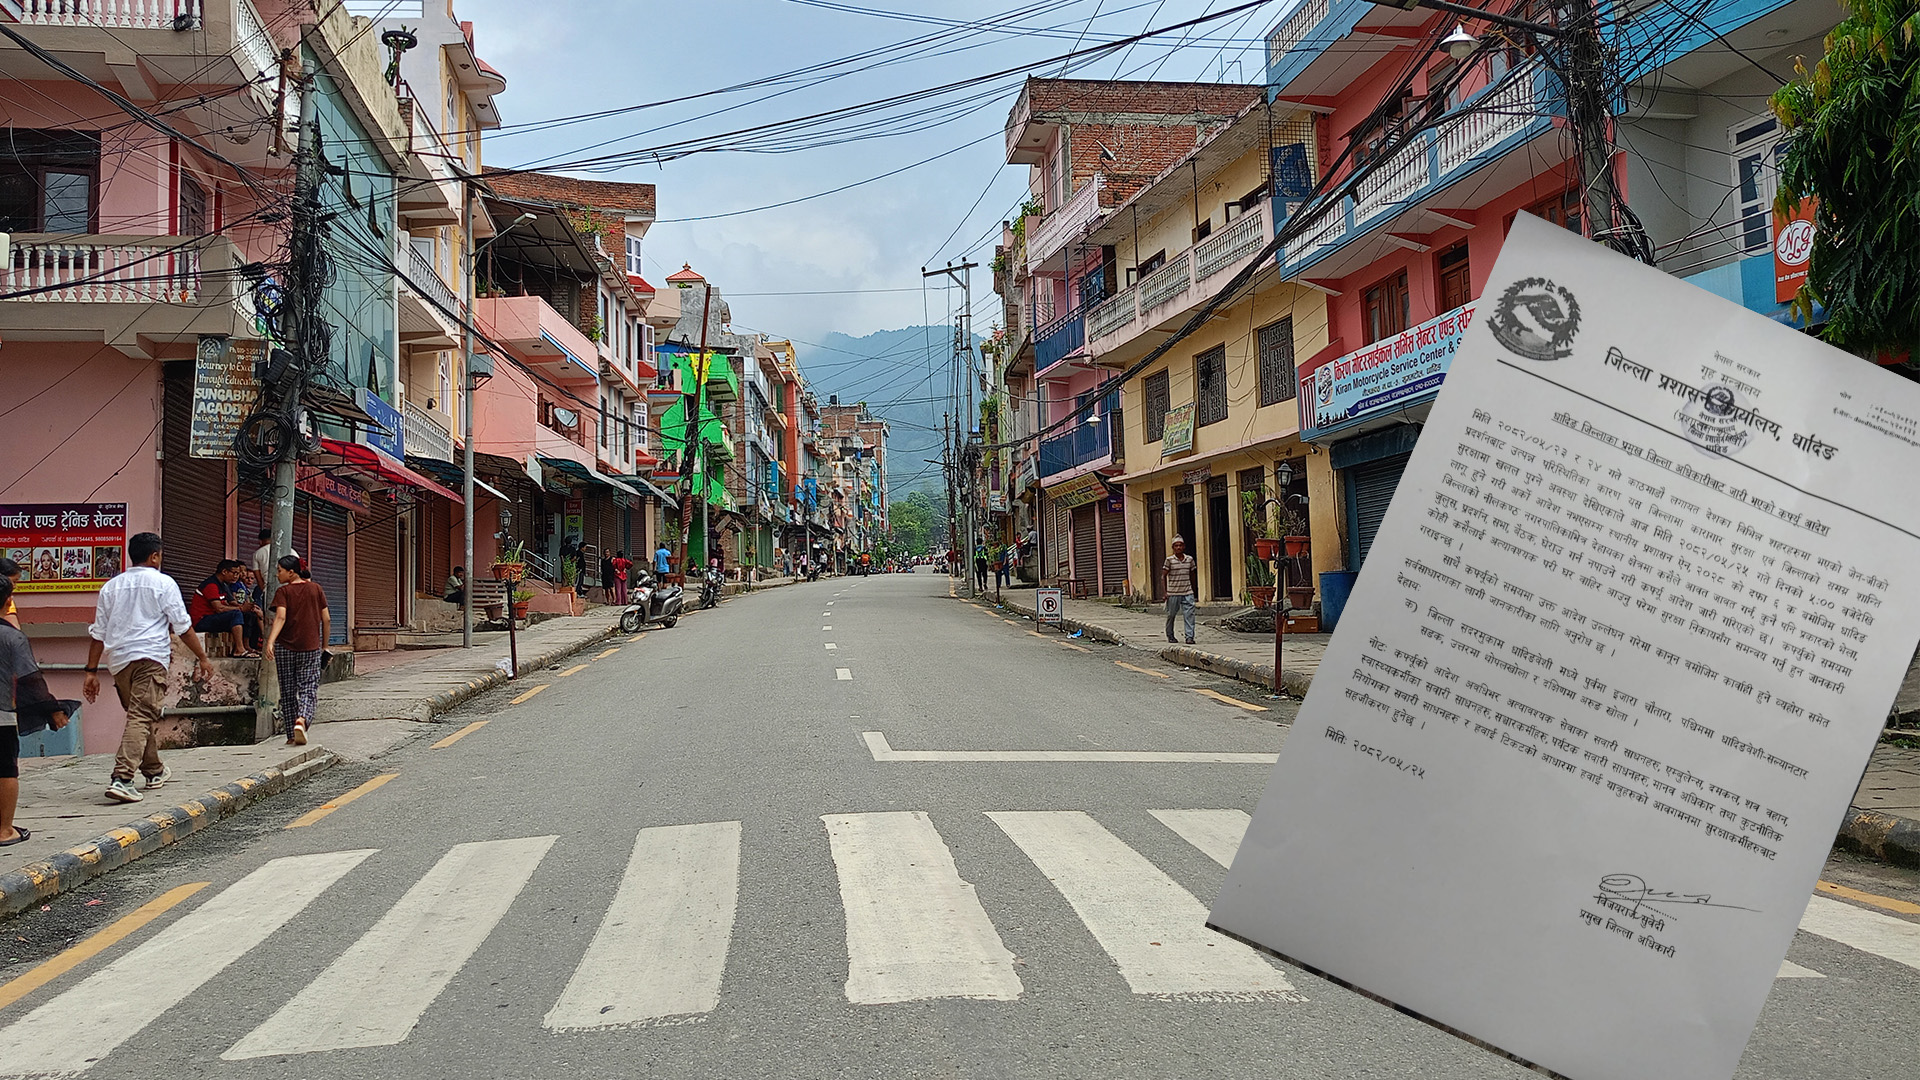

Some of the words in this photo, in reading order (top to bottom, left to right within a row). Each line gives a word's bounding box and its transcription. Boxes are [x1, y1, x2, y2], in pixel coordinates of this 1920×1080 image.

[1334, 358, 1351, 382] किरण
[1415, 324, 1437, 351] सेन्टर
[1438, 317, 1455, 340] एण्ड
[1335, 380, 1352, 396] Kiran
[1352, 366, 1390, 390] Motorcycle
[1390, 356, 1418, 378] Service
[1419, 348, 1447, 365] Center
[1448, 341, 1455, 353] &
[1701, 365, 1716, 379] गृह
[1721, 373, 1761, 398] मन्त्रालय
[1714, 350, 1733, 366] नेपाल
[1736, 363, 1760, 378] सरकार
[195, 388, 258, 402] SUNGABHA
[1604, 346, 1653, 382] जिल्ला
[1792, 432, 1838, 460] धादिङ
[1471, 408, 1491, 424] मिति
[1498, 420, 1567, 457] २०८२/०५/२३
[1574, 454, 1581, 463] र
[1588, 459, 1601, 471] २४
[1608, 468, 1621, 480] गते
[1670, 495, 1700, 513] लगायत
[1706, 507, 1731, 527] देशका
[1736, 521, 1763, 541] विभिन्न
[1817, 557, 1842, 573] भएको
[1553, 411, 1578, 425] धादिङ
[1581, 420, 1618, 443] जिल्लाका
[1622, 440, 1643, 453] प्रमुख
[1646, 448, 1672, 466] जिल्ला
[1729, 486, 1747, 498] जारी
[1751, 496, 1775, 510] भएको
[1804, 519, 1830, 533] आदेश
[1, 511, 31, 529] पार्लर
[35, 514, 58, 528] एण्ड
[61, 510, 89, 531] ट्रेनिङ
[93, 511, 124, 528] सेन्टर
[1457, 442, 1490, 463] सुरक्षामा
[1495, 458, 1519, 476] खलल
[1548, 482, 1577, 501] अवस्था
[1582, 493, 1624, 521] देखिएकाले
[1630, 518, 1648, 532] आज
[1653, 525, 1673, 542] मिति
[1679, 538, 1748, 576] २०८२/०५/२५
[1757, 571, 1770, 584] गते
[1775, 577, 1803, 598] दिनको
[1510, 445, 1535, 462] उत्पन्न
[1543, 459, 1589, 486] परिस्थितिका
[1597, 483, 1621, 499] कारण
[1628, 497, 1642, 509] यस
[1648, 503, 1683, 527] जिल्लामा
[1690, 524, 1724, 545] कारागार
[1730, 542, 1754, 557] सुरक्षा
[1781, 560, 1820, 584] जिल्लाको
[1856, 592, 1881, 607] शान्ति
[1442, 473, 1479, 498] जिल्लाको
[1483, 492, 1520, 515] नीलकण्ठ
[1524, 511, 1587, 545] नगरपालिकाभित्र
[1591, 537, 1624, 561] देहायका
[1628, 554, 1653, 573] क्षेत्रमा
[1657, 569, 1681, 585] कसैले
[1685, 582, 1709, 597] आवत
[1713, 593, 1737, 609] जावत
[1759, 613, 1776, 626] कुनै
[1781, 621, 1796, 633] पनि
[1799, 630, 1834, 650] प्रकारको
[1404, 557, 1461, 589] सर्वसाधारणका
[1489, 595, 1536, 622] जानकारीका
[1539, 617, 1560, 632] लागि
[1564, 628, 1592, 646] अनुरोध
[1595, 641, 1605, 653] छ
[1443, 554, 1460, 568] साथै
[1503, 581, 1534, 601] समयमा
[1538, 596, 1557, 611] उक्त
[1561, 607, 1586, 624] आदेश
[1629, 635, 1651, 652] गरेमा
[1655, 647, 1680, 665] कानून
[1808, 712, 1830, 727] समेत
[1345, 687, 1390, 713] सहजीकरण
[1391, 708, 1415, 726] हुनेछ
[1352, 668, 1390, 693] नियोगका
[1394, 688, 1419, 705] सवारी
[1422, 701, 1460, 723] साधनहरु
[1464, 718, 1470, 727] र
[1474, 723, 1497, 739] हवाई
[1500, 732, 1537, 756] टिकटको
[1541, 752, 1576, 773] आधारमा
[1580, 769, 1602, 785] हवाई
[1353, 739, 1424, 779] २०८२/०५/२५
[1579, 908, 1602, 925] प्रमुख
[1605, 917, 1633, 939] जिल्ला
[1637, 935, 1675, 958] अधिकारी
